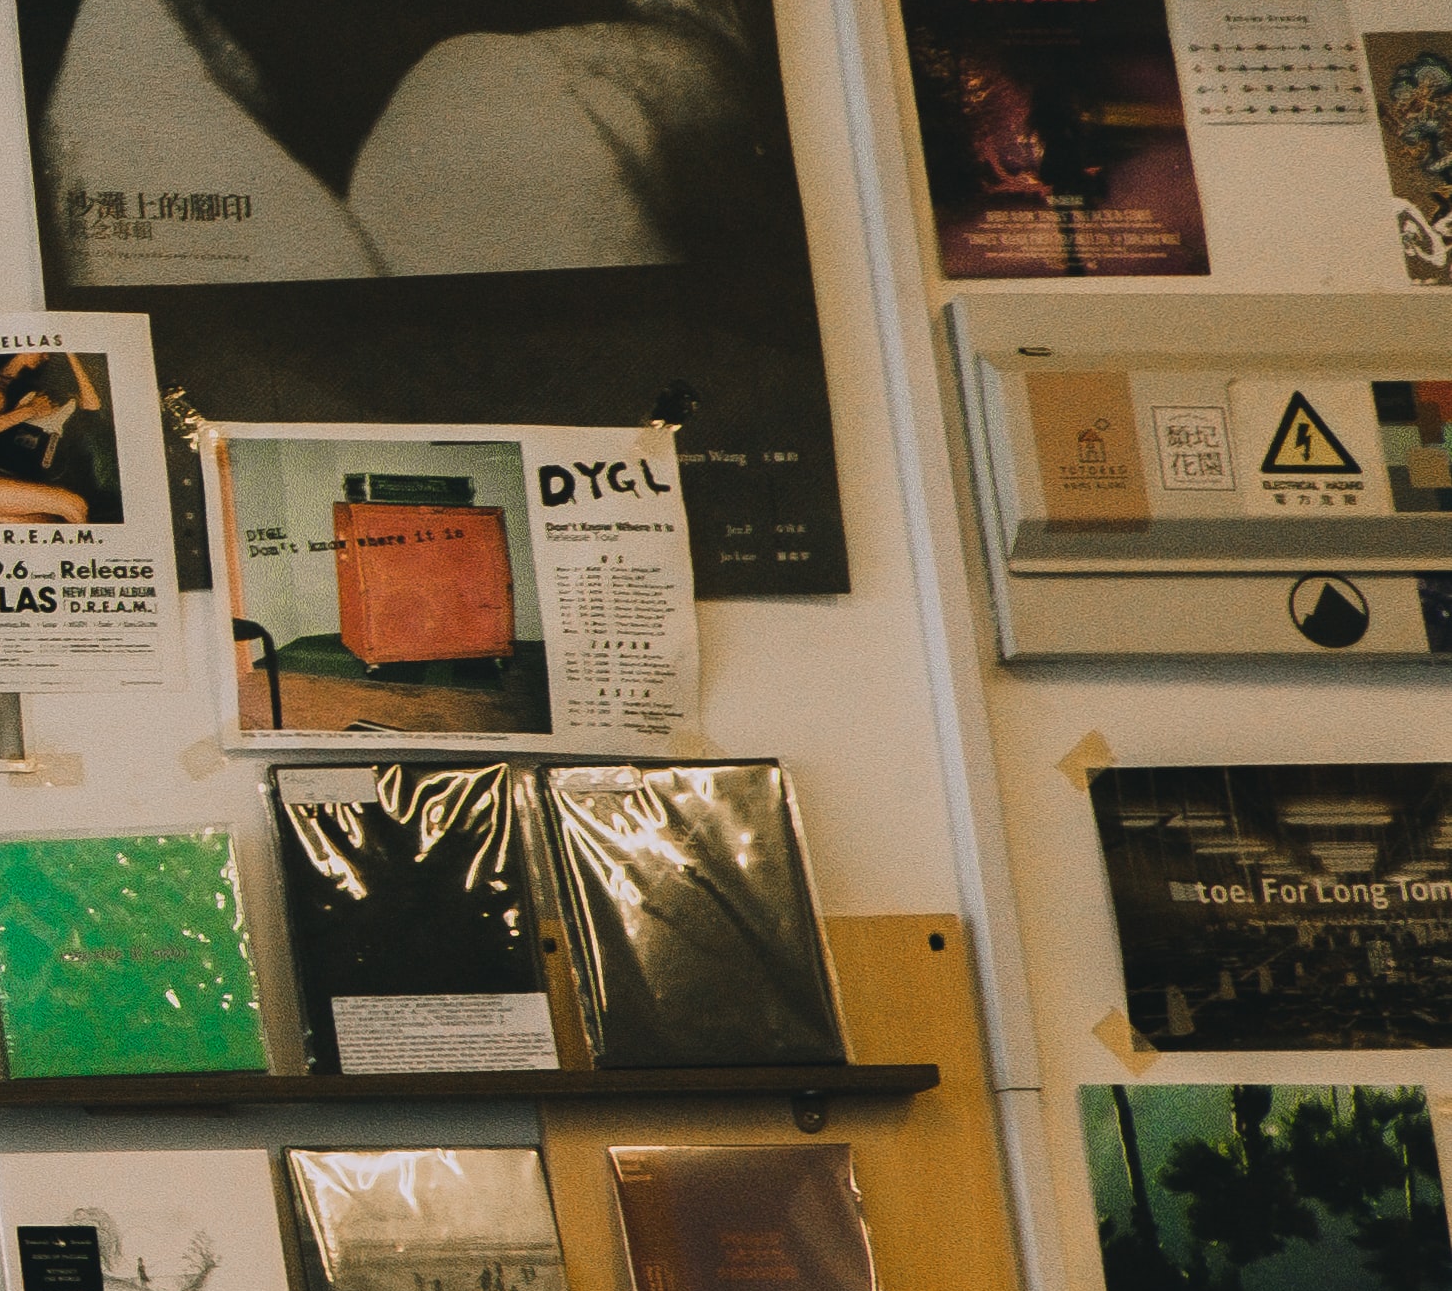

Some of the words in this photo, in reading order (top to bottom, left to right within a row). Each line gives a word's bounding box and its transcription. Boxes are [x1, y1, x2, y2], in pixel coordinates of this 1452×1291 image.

[539, 458, 672, 508] DYGL
[1262, 479, 1319, 492] ELECTRICAL
[246, 527, 287, 542] DYGL
[414, 529, 436, 543] it
[444, 528, 465, 542] is
[60, 559, 155, 580] Release
[119, 586, 157, 599] ALBUM
[1262, 878, 1310, 904] For
[1314, 878, 1390, 911] Long
